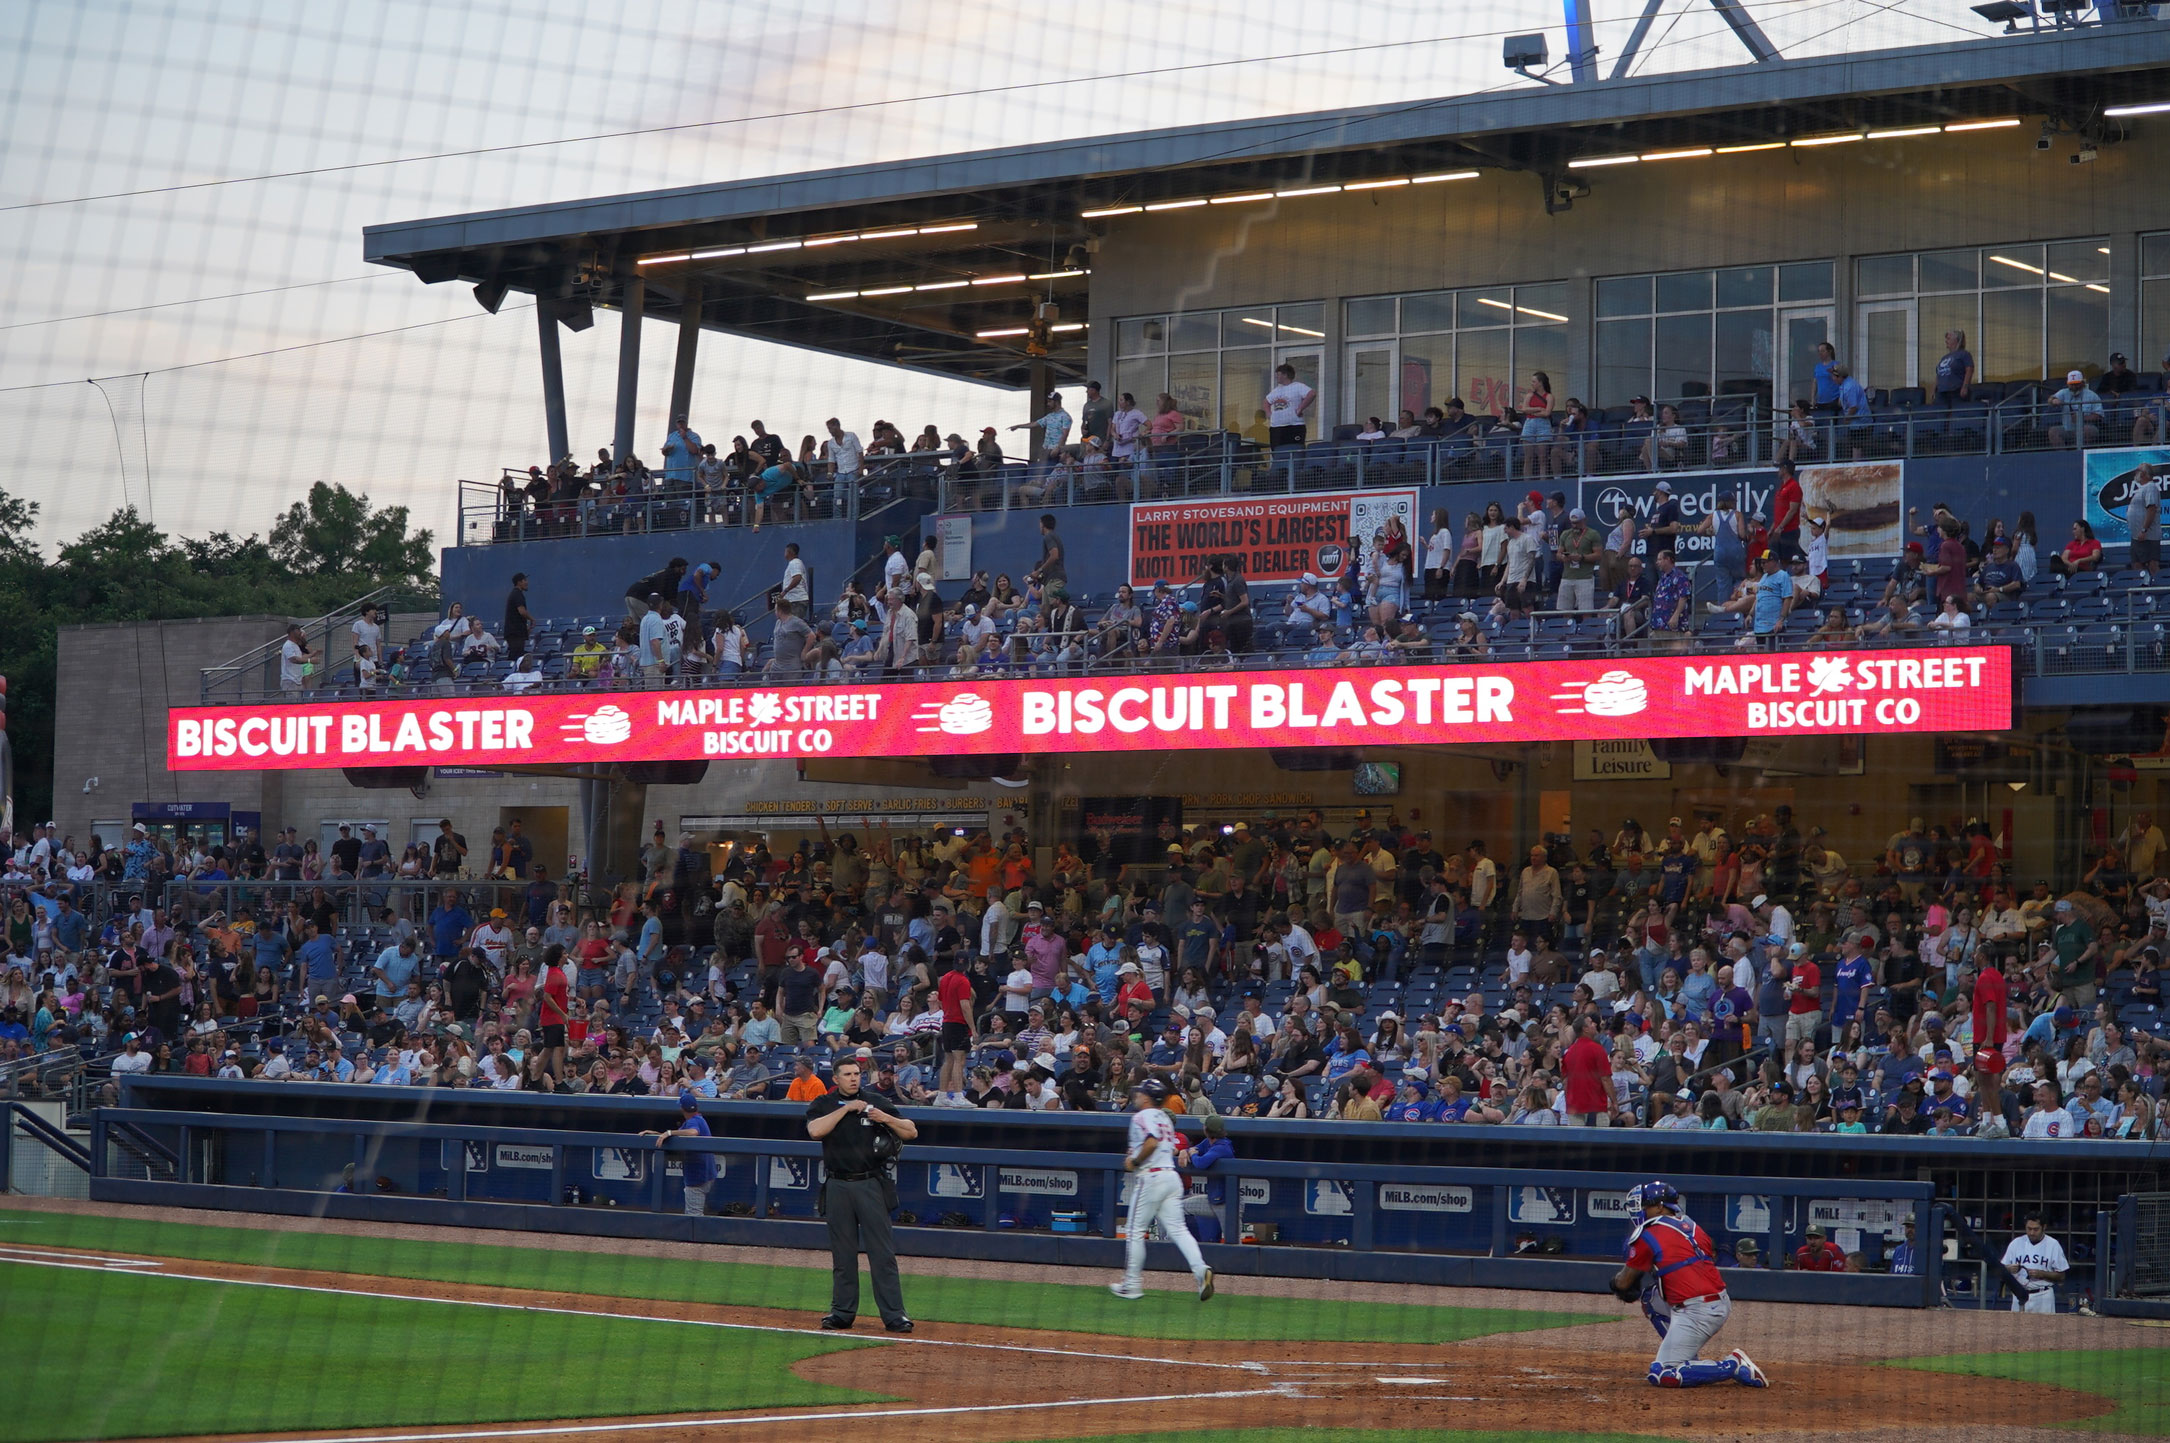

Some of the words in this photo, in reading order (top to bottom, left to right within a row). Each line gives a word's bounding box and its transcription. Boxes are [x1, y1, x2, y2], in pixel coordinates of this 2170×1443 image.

[1136, 510, 1180, 523] LARRY
[1183, 505, 1264, 520] STOVESAND
[1268, 500, 1350, 515] EQUIPMENT
[1136, 524, 1171, 552] THE
[1176, 519, 1261, 549] WORLD'S
[1266, 514, 1349, 545] LARGEST
[1136, 556, 1175, 578] KIOTI
[1252, 549, 1310, 573] DEALER
[1685, 663, 1801, 696] MAPLE
[1856, 656, 1987, 691] STREET
[658, 698, 745, 726] MAPLE
[785, 693, 882, 723] STREET
[1022, 684, 1238, 735] BISCUIT
[1250, 675, 1515, 729] BLASTER
[1747, 698, 1868, 729] BISCUIT
[1876, 697, 1921, 725] CO
[177, 716, 334, 757] BISCUIT
[341, 709, 534, 753] BLASTER
[703, 729, 793, 755] BISCUIT
[798, 728, 833, 753] CO
[1592, 738, 1648, 756] Family
[1592, 757, 1652, 774] Leisure
[745, 800, 779, 813] CHICKEN
[782, 799, 817, 812] TENDERS
[825, 799, 847, 812] SOFT
[848, 799, 874, 811] SERVE
[882, 798, 912, 811] GARLIC
[914, 797, 938, 810] FRIES
[946, 796, 985, 809] BURGERS
[1209, 793, 1233, 805] PORK
[1237, 792, 1261, 805] CHOP
[1264, 791, 1313, 804] SANDWICH
[500, 1151, 553, 1164] MiLB.com/sh
[1000, 1174, 1073, 1191] MiLB.com/shop
[1384, 1191, 1468, 1208] MiLB.com/shop
[2015, 1254, 2049, 1268] NASH
